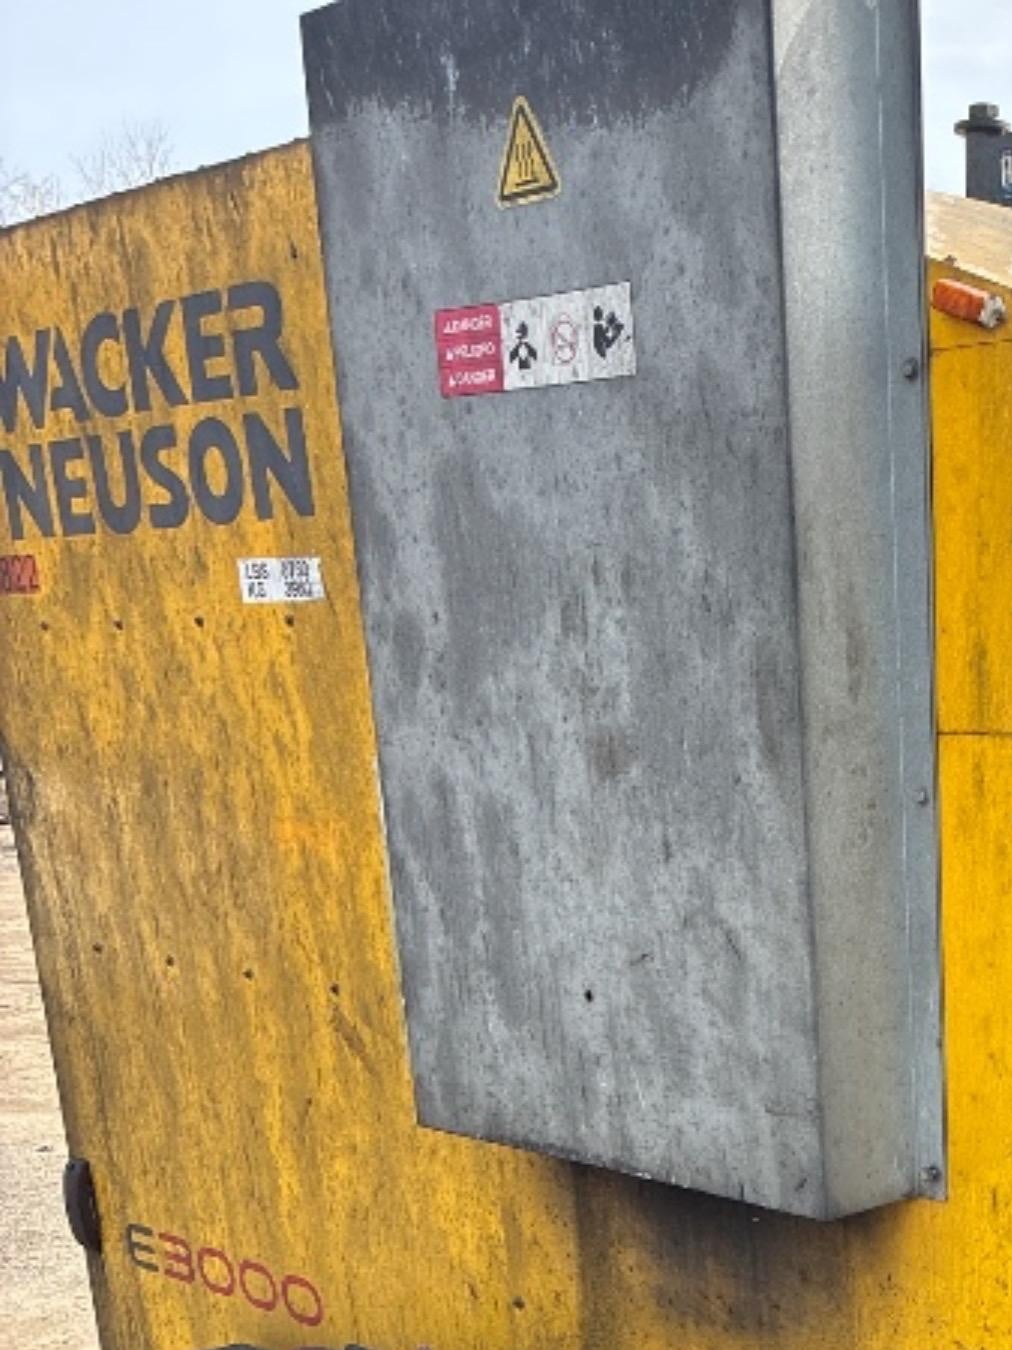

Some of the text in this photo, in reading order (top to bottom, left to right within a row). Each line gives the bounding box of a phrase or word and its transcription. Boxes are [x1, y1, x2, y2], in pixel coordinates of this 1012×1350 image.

[0, 281, 299, 433] WACKER
[0, 407, 315, 540] NEUSON
[127, 1223, 325, 1327] E3000
